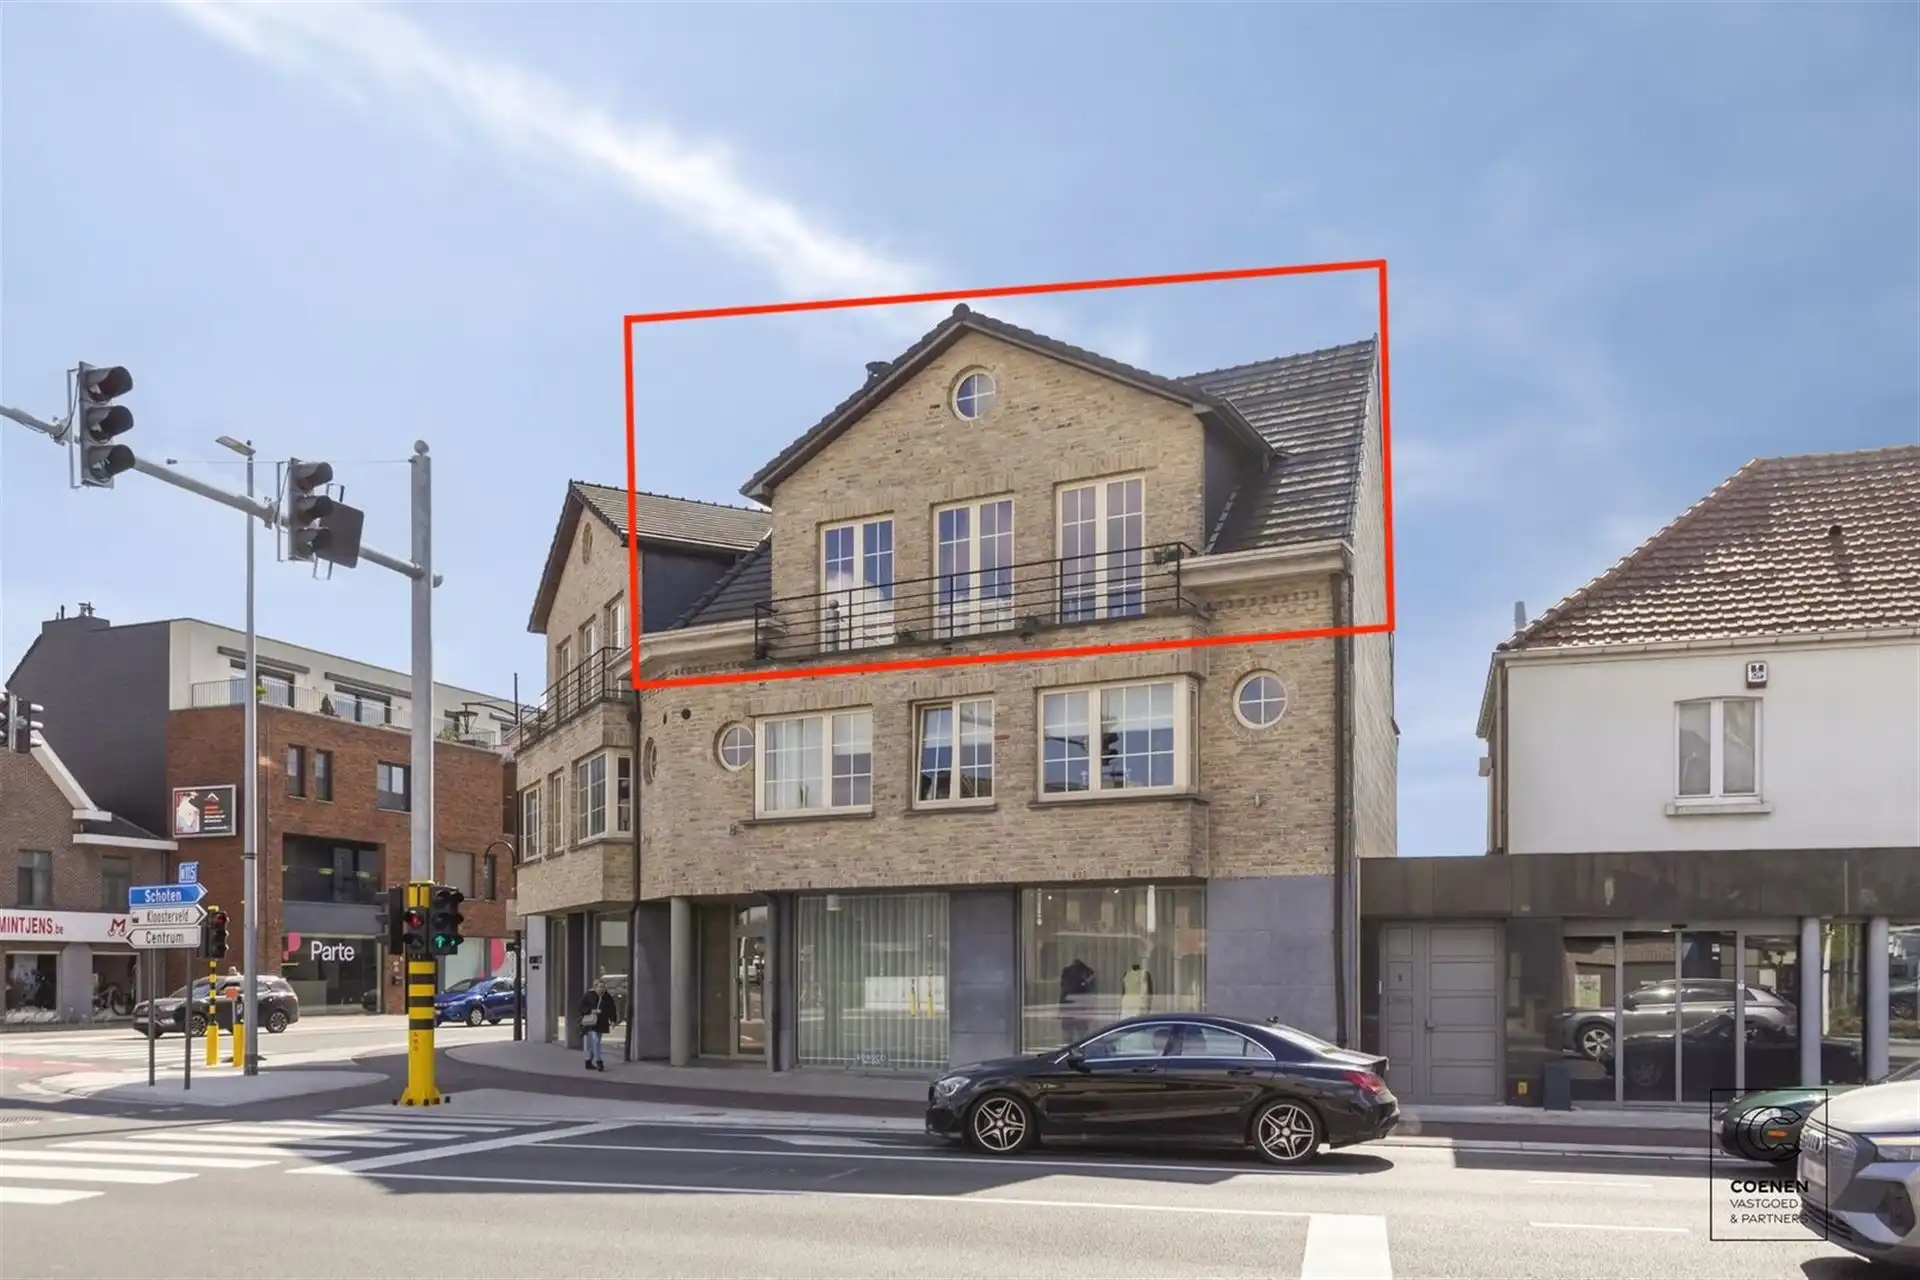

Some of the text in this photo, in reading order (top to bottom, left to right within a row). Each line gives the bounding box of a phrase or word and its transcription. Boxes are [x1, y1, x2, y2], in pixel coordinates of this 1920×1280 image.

[144, 889, 182, 903] Schoten
[146, 909, 189, 923] Kloosterveld
[145, 930, 184, 944] Centrum
[311, 940, 355, 961] Parte
